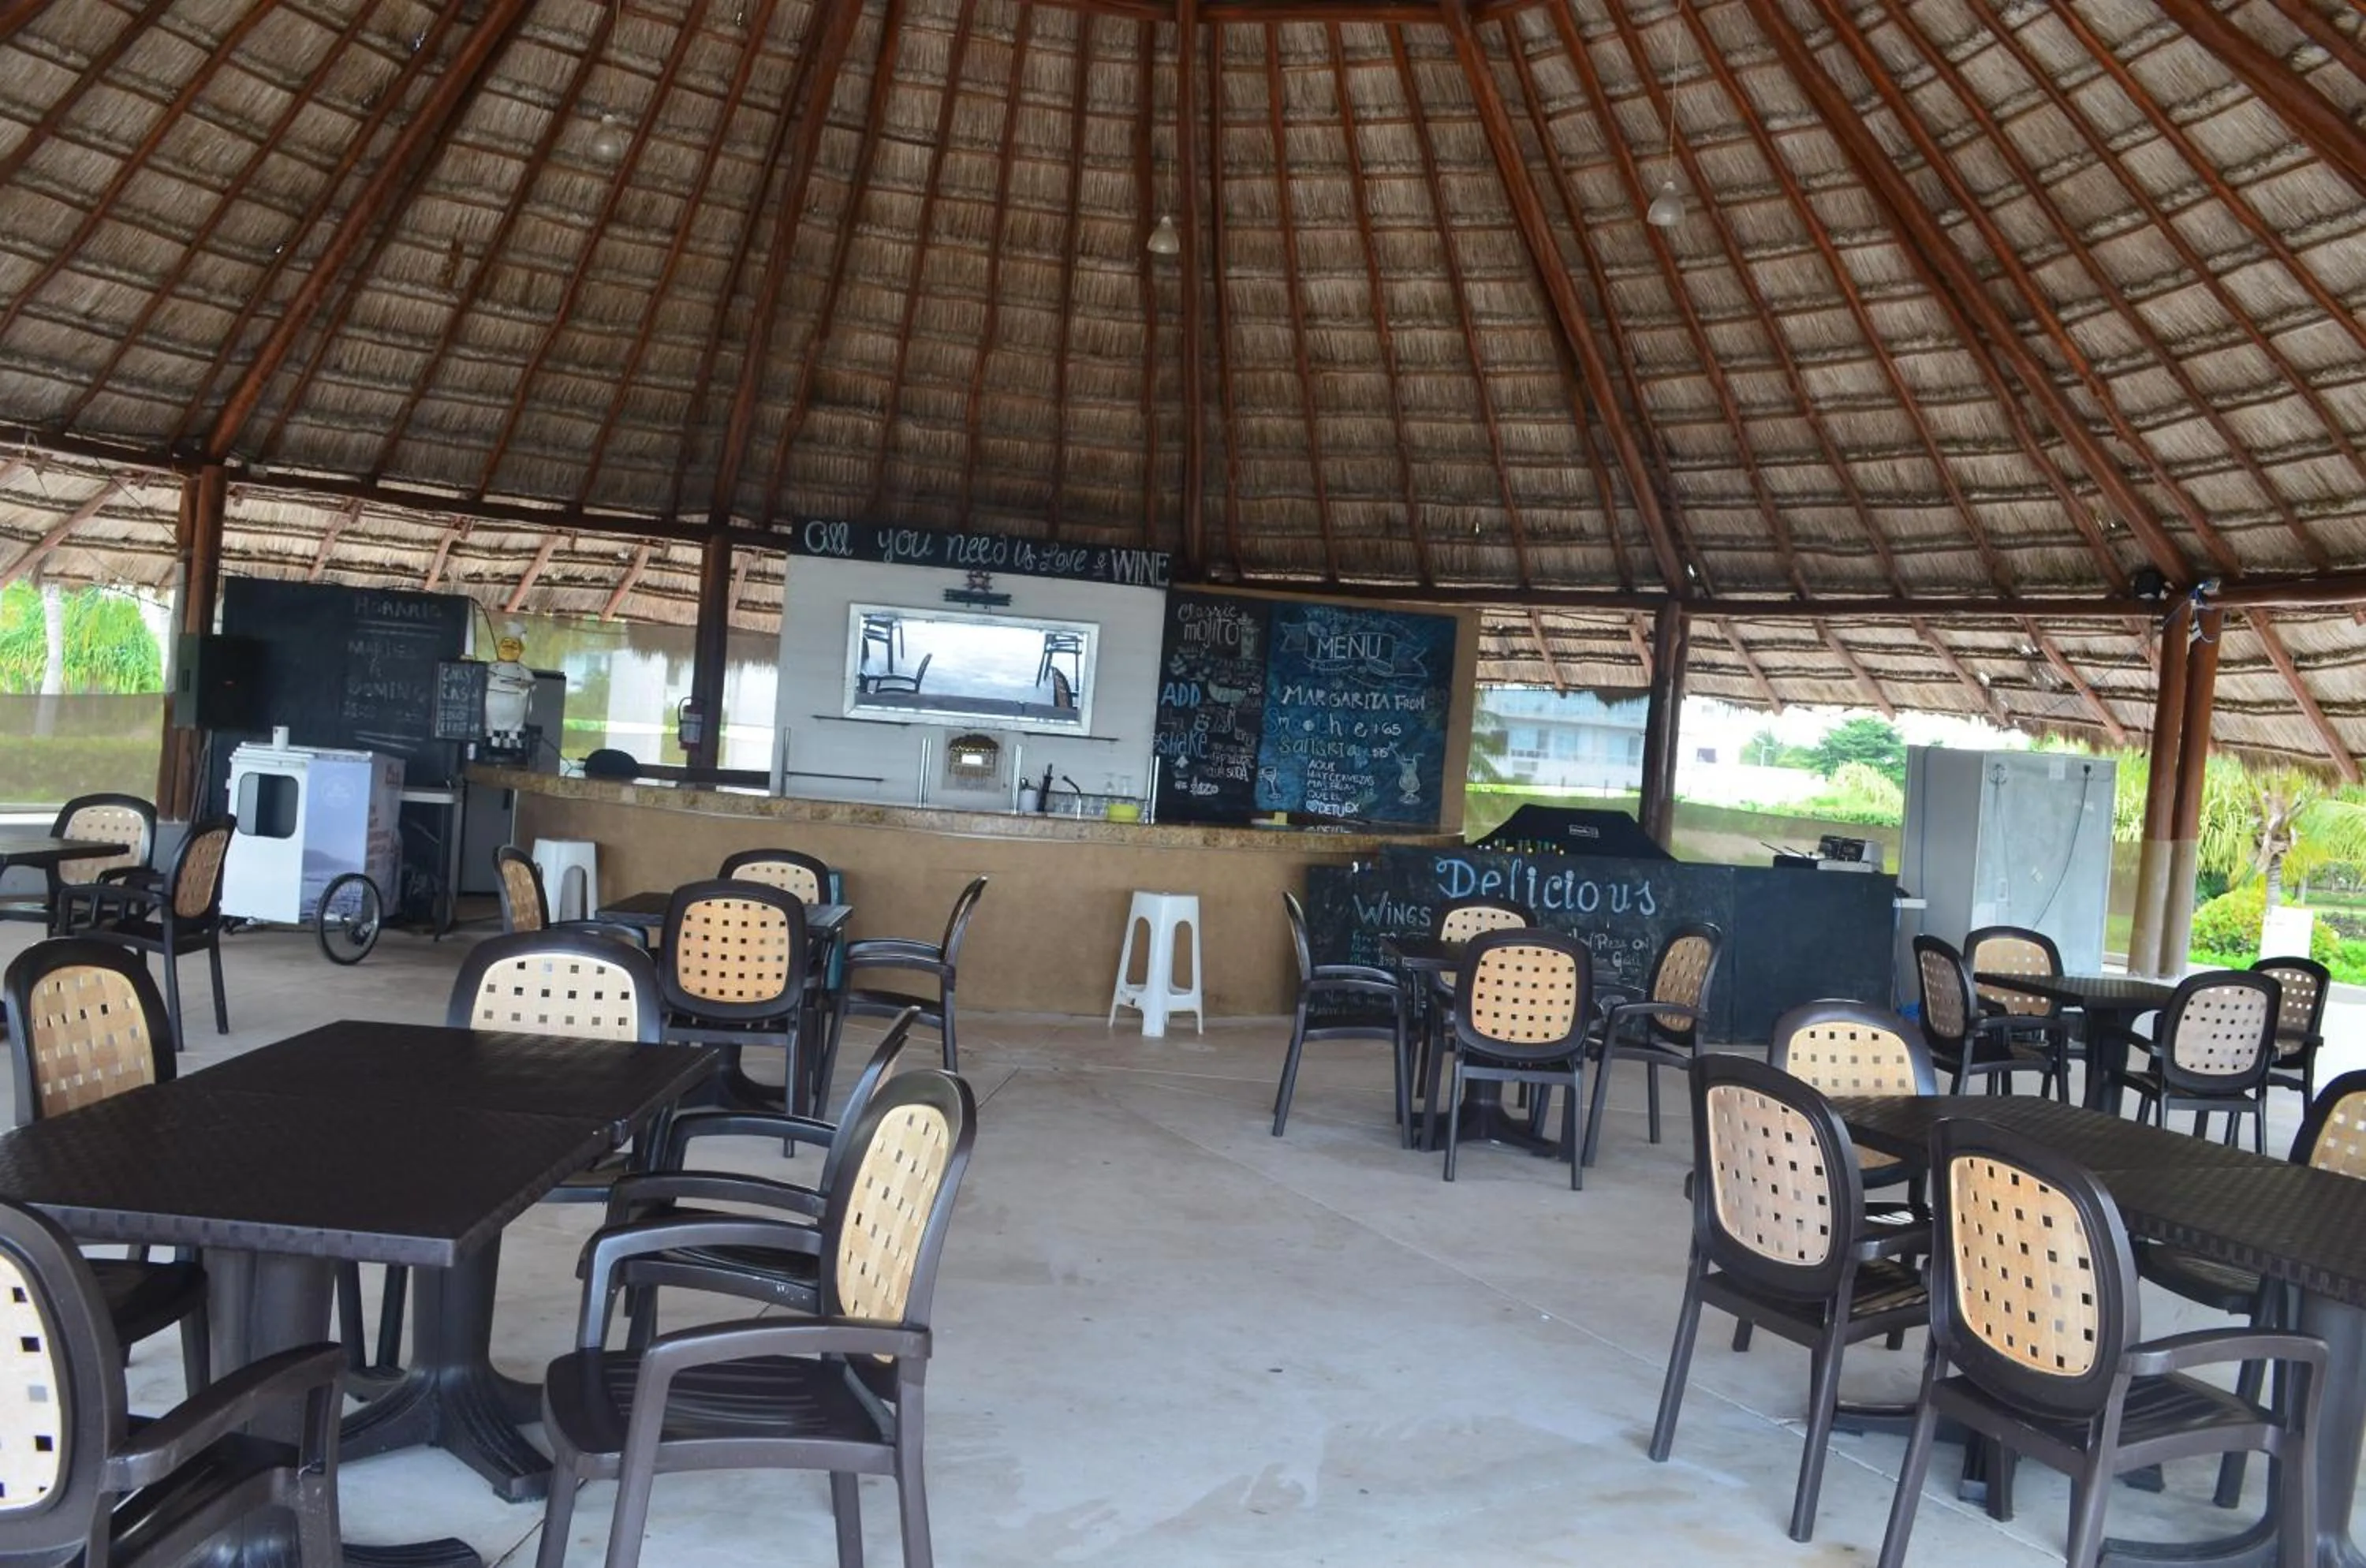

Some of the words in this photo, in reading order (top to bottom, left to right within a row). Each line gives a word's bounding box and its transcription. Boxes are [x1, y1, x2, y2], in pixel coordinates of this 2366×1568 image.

[878, 528, 934, 563] you
[947, 533, 1008, 565] need
[1110, 548, 1171, 587] WINE
[1315, 635, 1382, 659] MENU
[1160, 681, 1201, 708] ADD
[1281, 685, 1390, 711] MARGARITA
[1435, 857, 1657, 916] Delicious
